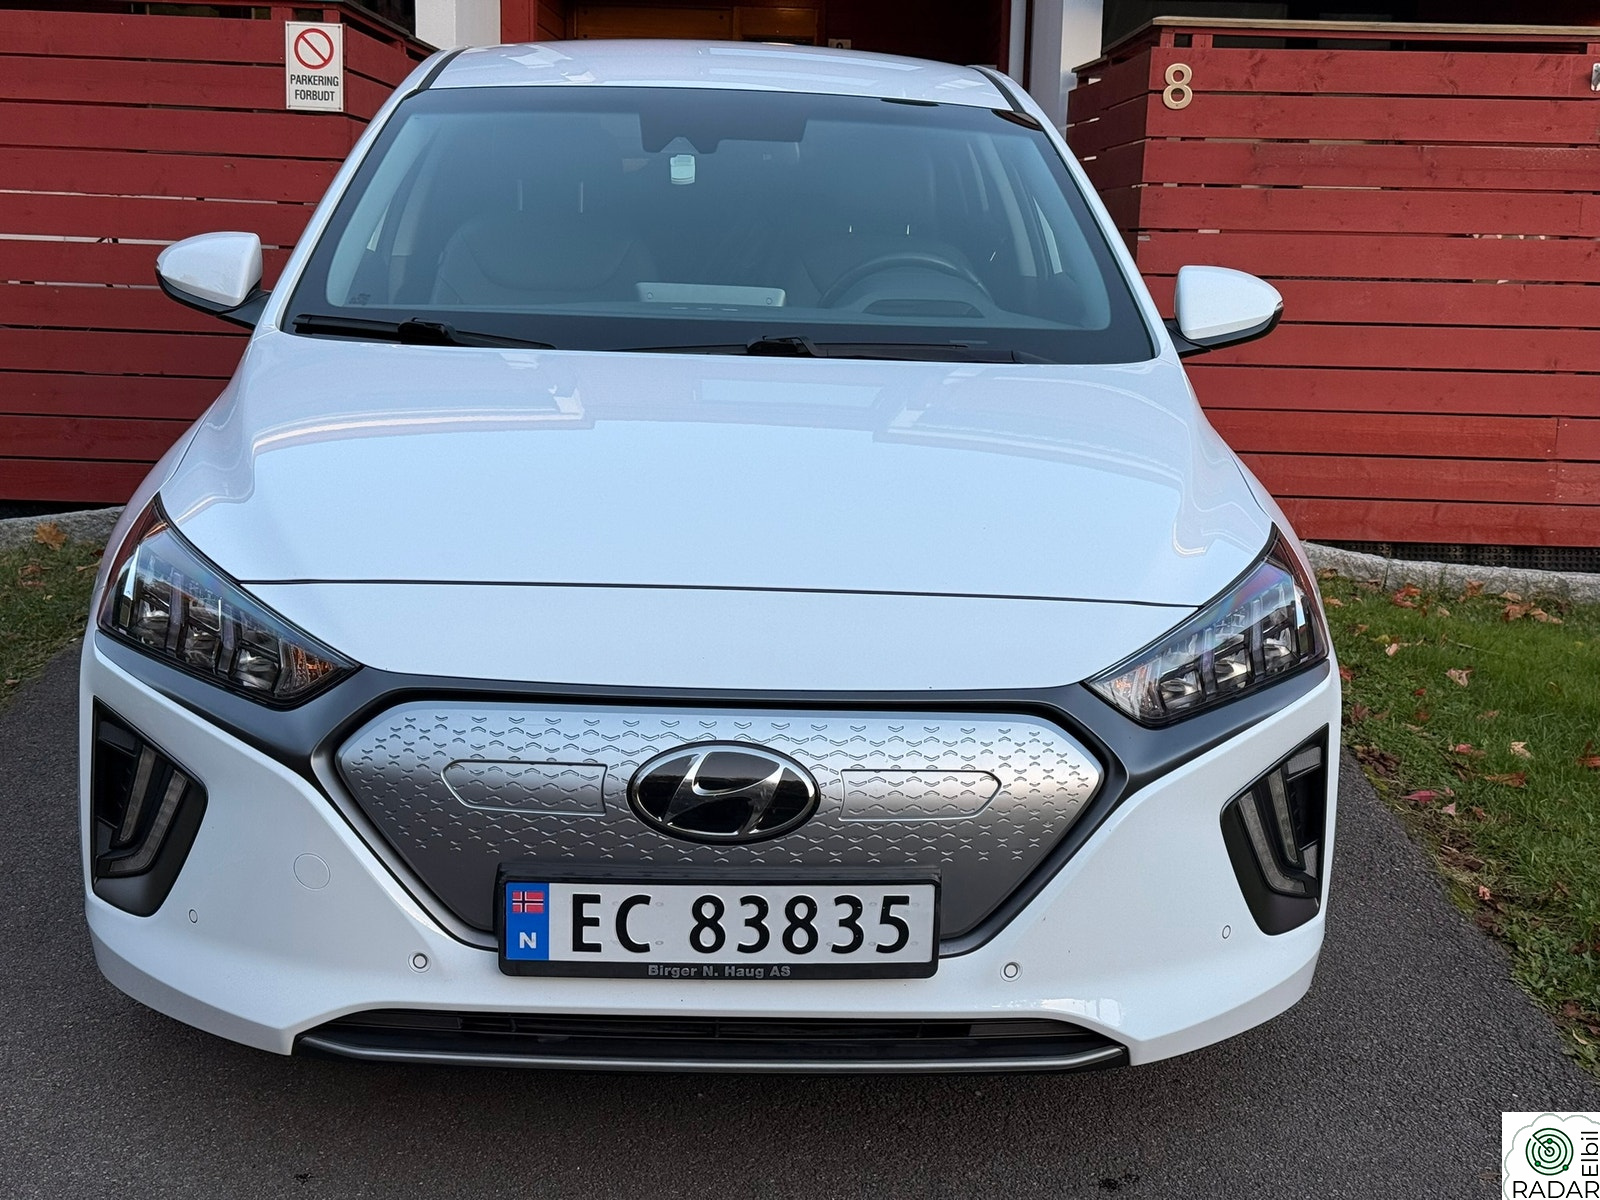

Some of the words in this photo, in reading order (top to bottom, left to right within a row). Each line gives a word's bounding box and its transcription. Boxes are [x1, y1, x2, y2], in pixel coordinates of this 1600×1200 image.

[290, 74, 339, 86] PARKERING
[1163, 63, 1192, 110] 8
[294, 90, 335, 101] FORBUDT
[572, 894, 652, 953] EC
[689, 893, 911, 954] 83835
[519, 932, 537, 949] N
[648, 965, 697, 979] Birger
[702, 965, 719, 977] N.
[724, 966, 765, 979] Haug
[769, 966, 791, 977] AS
